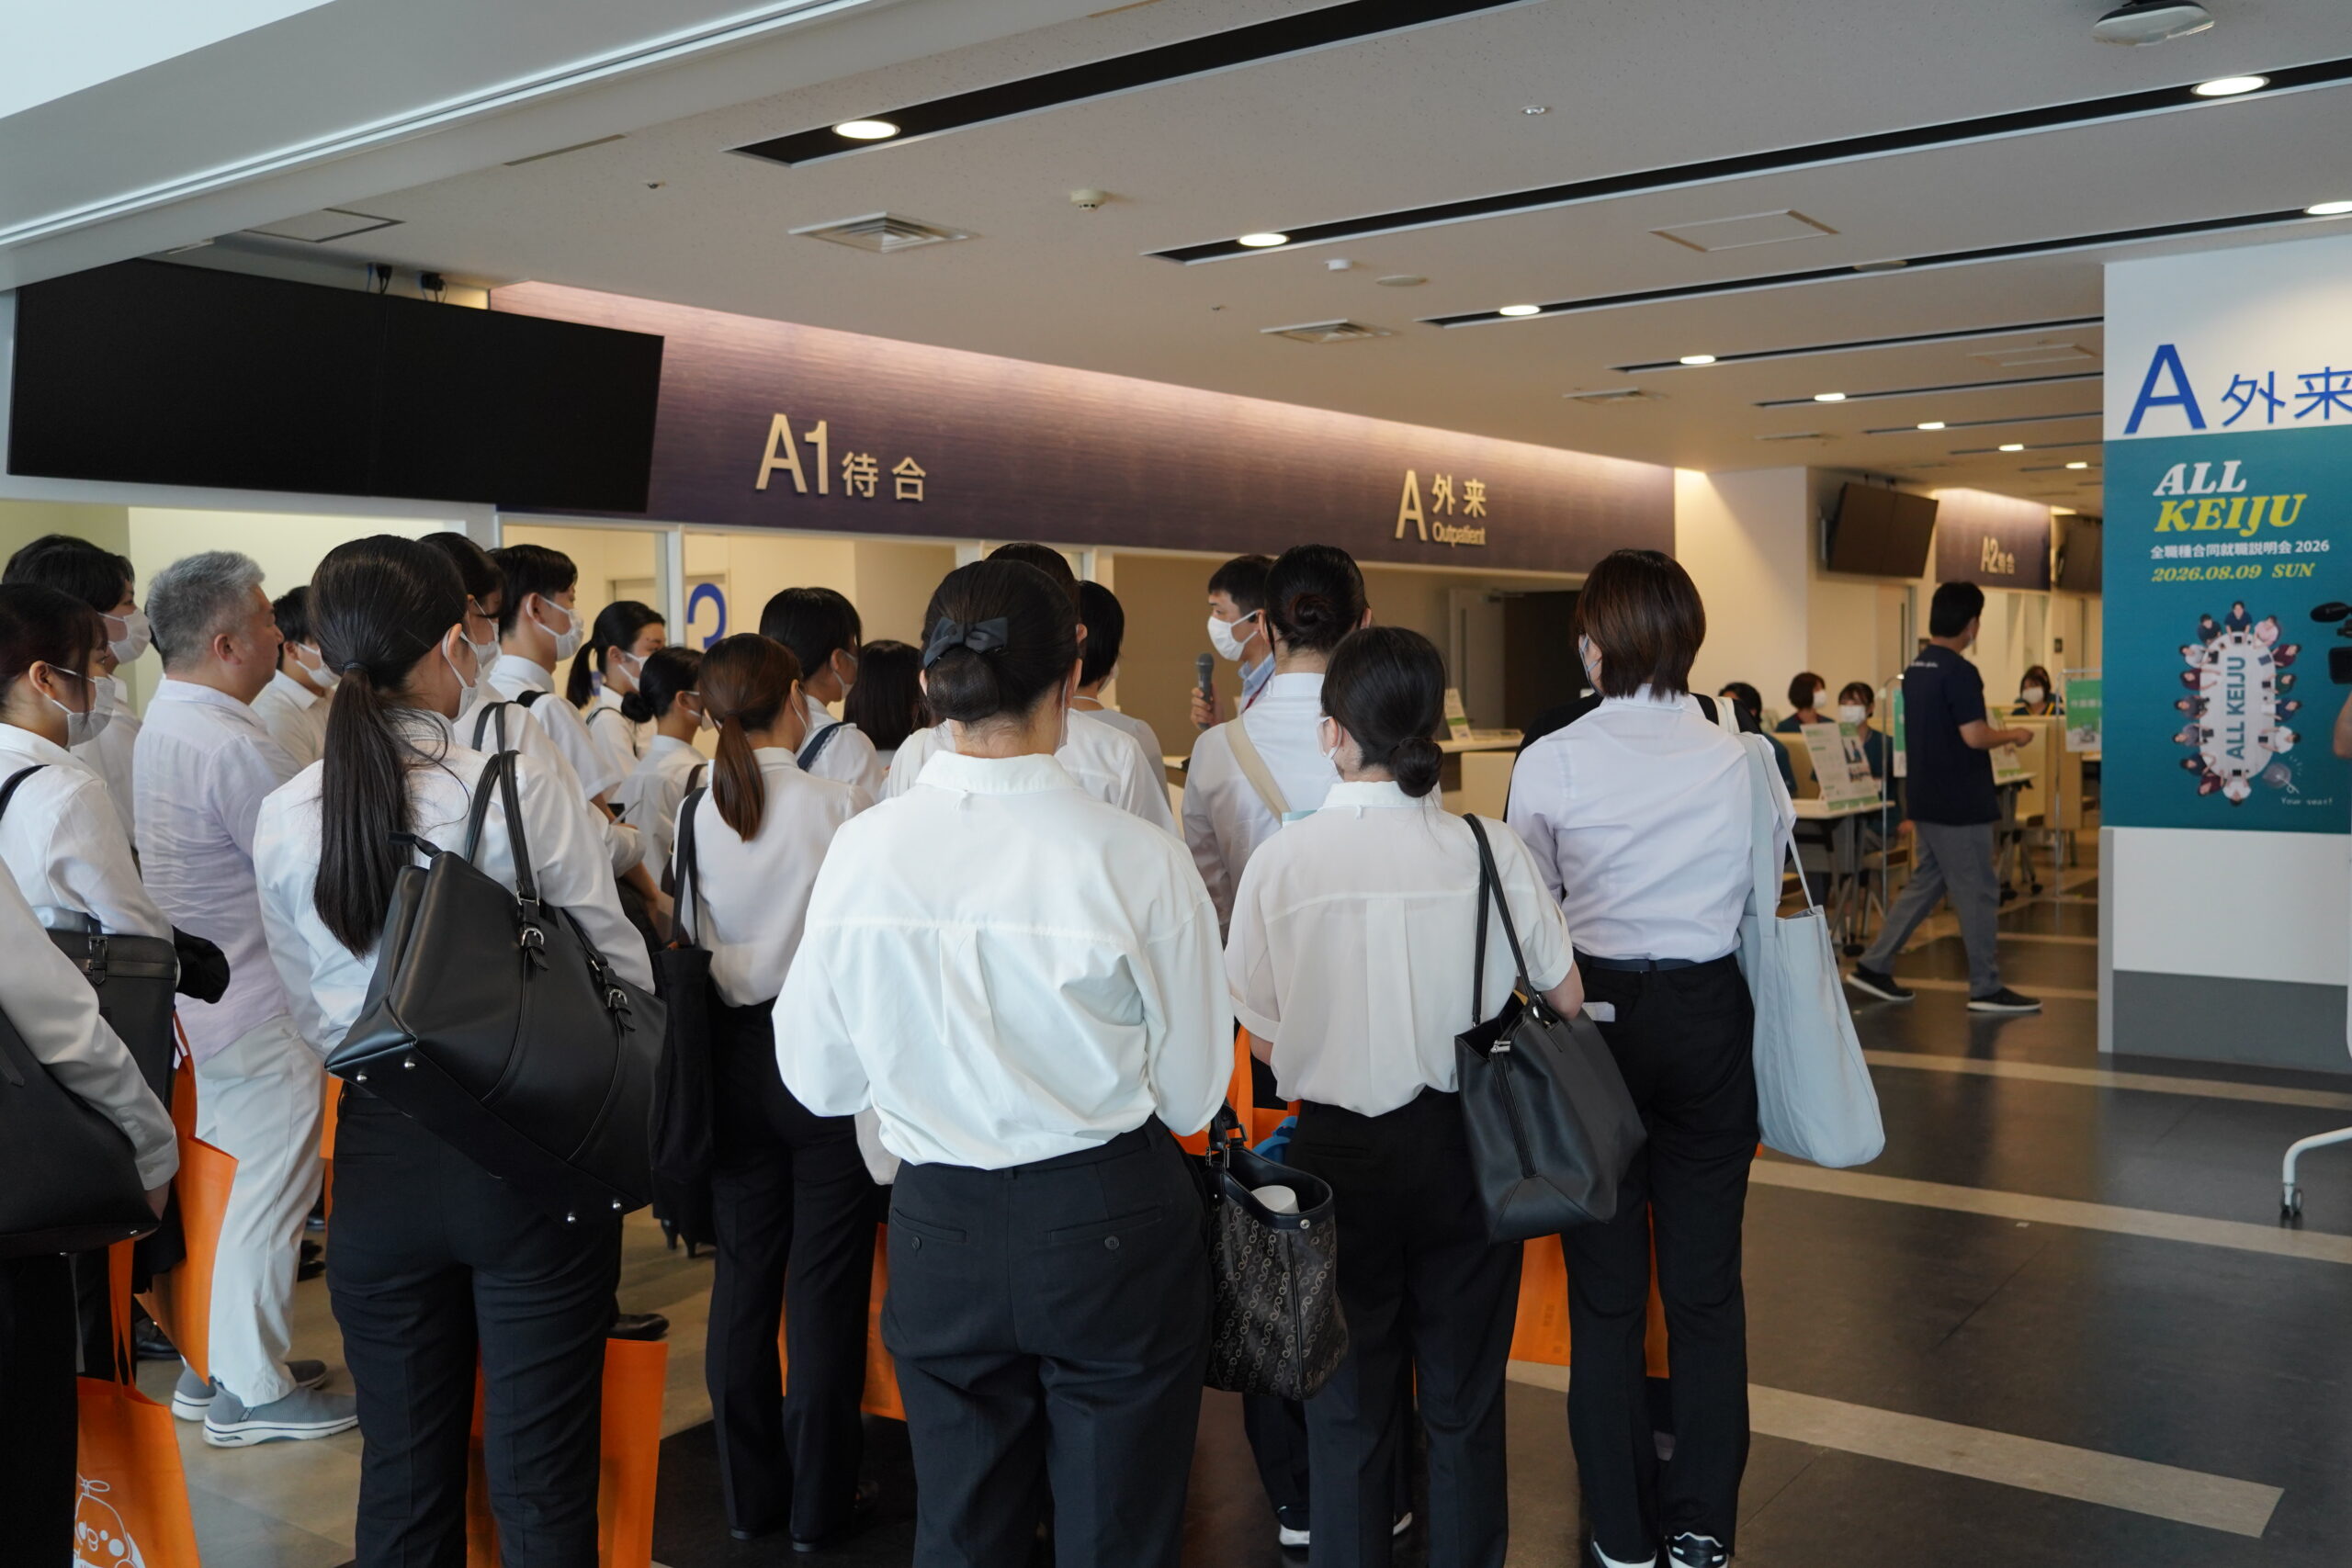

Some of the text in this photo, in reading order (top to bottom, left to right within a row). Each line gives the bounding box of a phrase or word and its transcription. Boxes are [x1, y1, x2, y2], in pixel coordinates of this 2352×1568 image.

[2123, 344, 2352, 435] A 外来
[755, 412, 927, 502] A1 待合
[2153, 460, 2247, 496] ALL
[1395, 469, 1487, 541] A 外来
[2154, 494, 2307, 536] KEIJU
[1431, 521, 1487, 547] Outpatient
[2151, 539, 2331, 559] 全職種合同就職説明会 2026
[2151, 562, 2316, 582] 2026.08.09 SUN
[2226, 656, 2245, 761] ALL KEIJU
